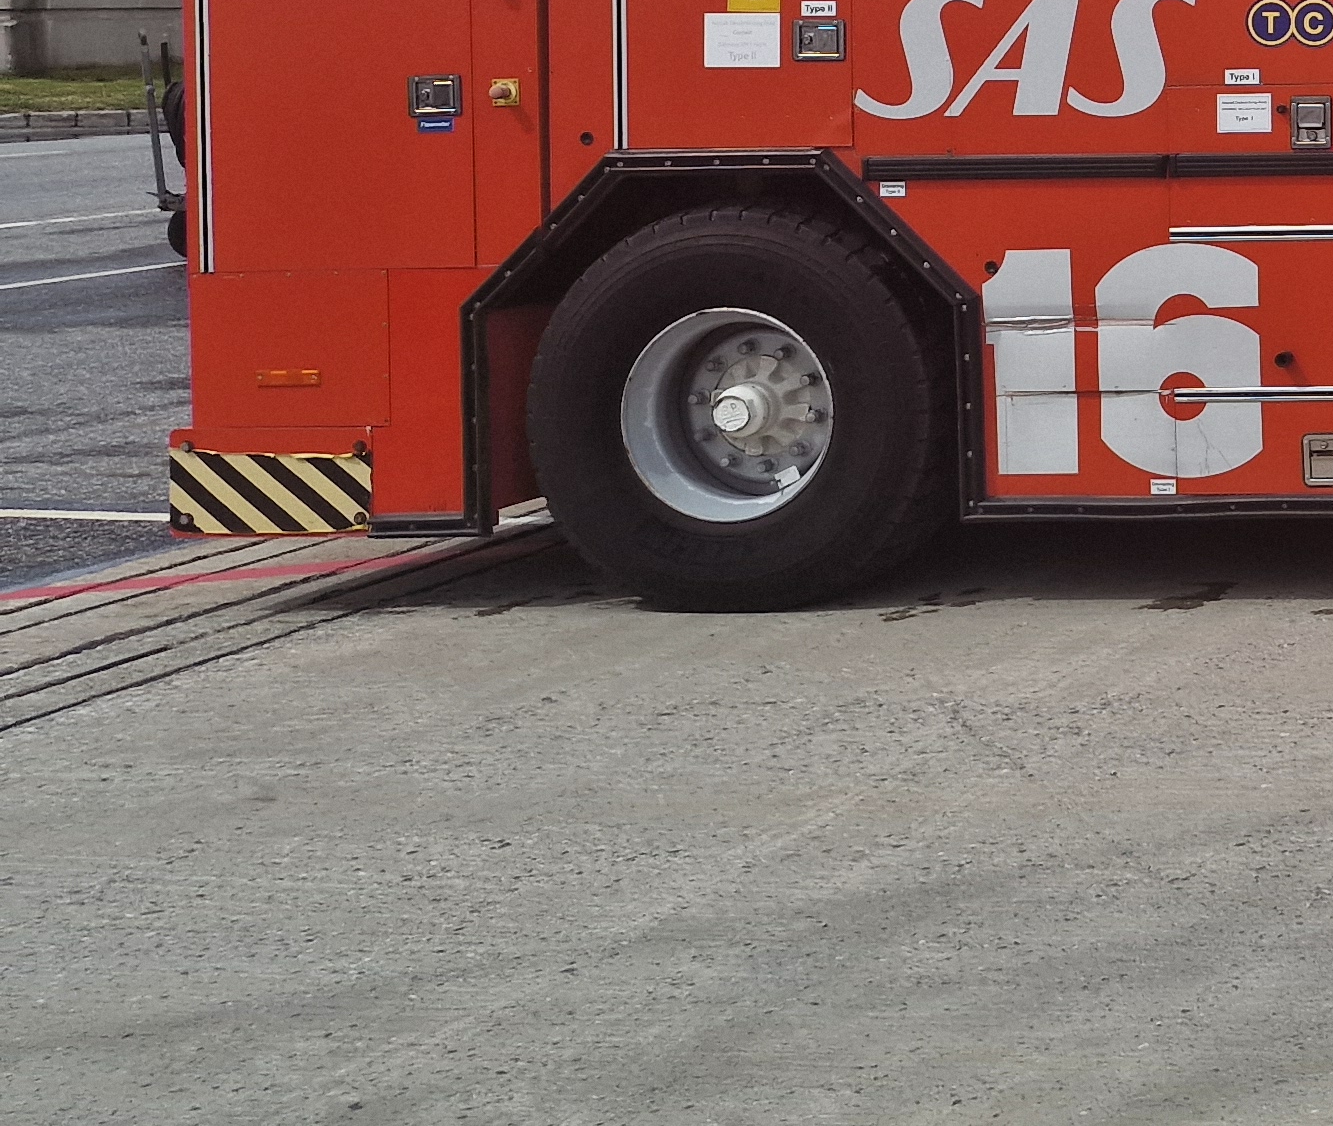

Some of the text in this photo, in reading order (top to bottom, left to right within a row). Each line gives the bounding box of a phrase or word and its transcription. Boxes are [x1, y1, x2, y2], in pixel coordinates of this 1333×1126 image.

[804, 4, 833, 13] Type II
[728, 51, 750, 62] Type
[1228, 72, 1250, 82] Type
[982, 243, 1264, 478] 16
